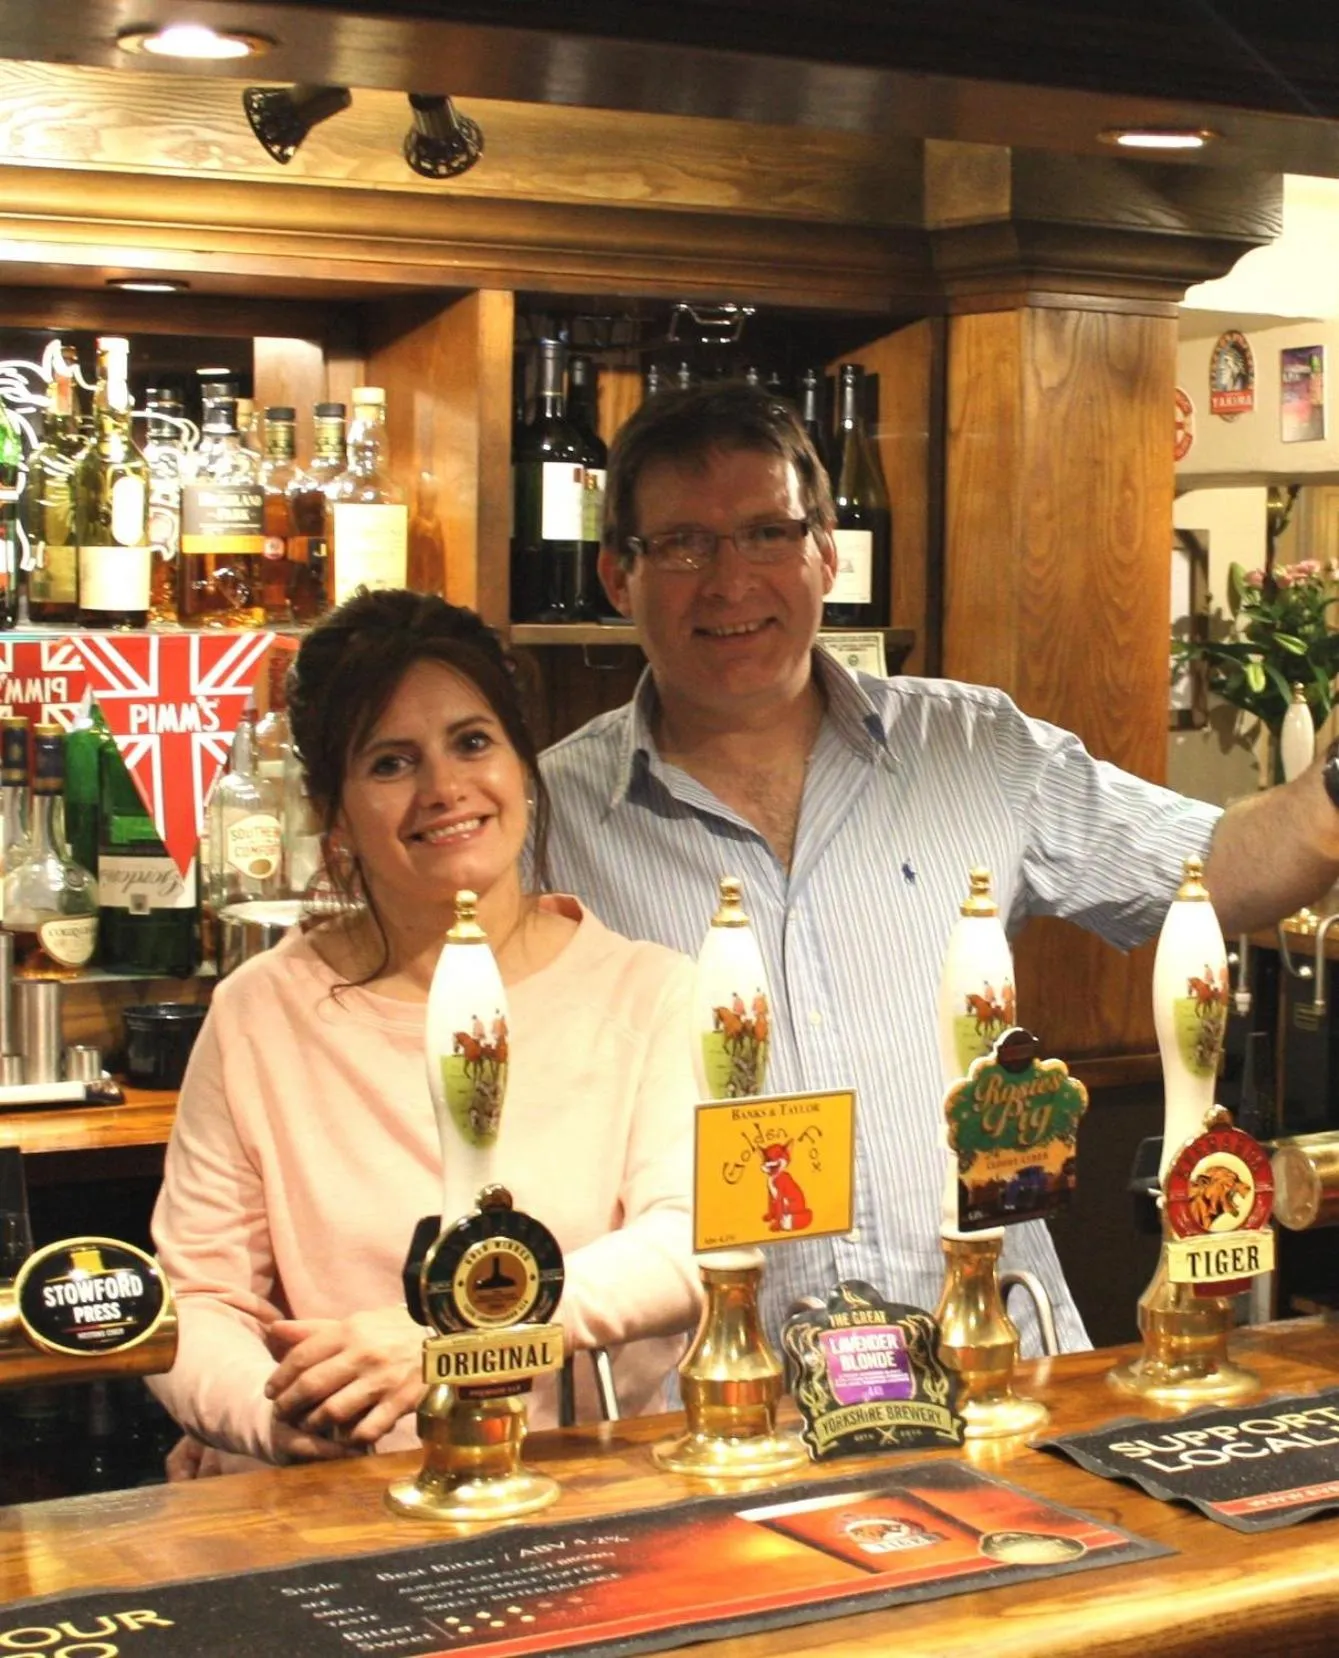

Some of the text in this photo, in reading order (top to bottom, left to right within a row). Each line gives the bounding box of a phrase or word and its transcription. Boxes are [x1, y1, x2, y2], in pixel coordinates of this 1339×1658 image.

[129, 695, 221, 734] PIMM'S
[779, 1103, 821, 1116] TAYLOR
[982, 1098, 1054, 1146] Pig
[722, 1123, 823, 1185] Golden Fox
[1186, 1245, 1260, 1278] TIGER
[42, 1271, 144, 1308] STOWFORD
[72, 1301, 122, 1324] PRESS
[436, 1342, 553, 1378] ORIGINAL
[887, 1405, 943, 1425] BREWERY
[1108, 1406, 1339, 1459] SUPPORT
[1142, 1432, 1339, 1473] LOCAL
